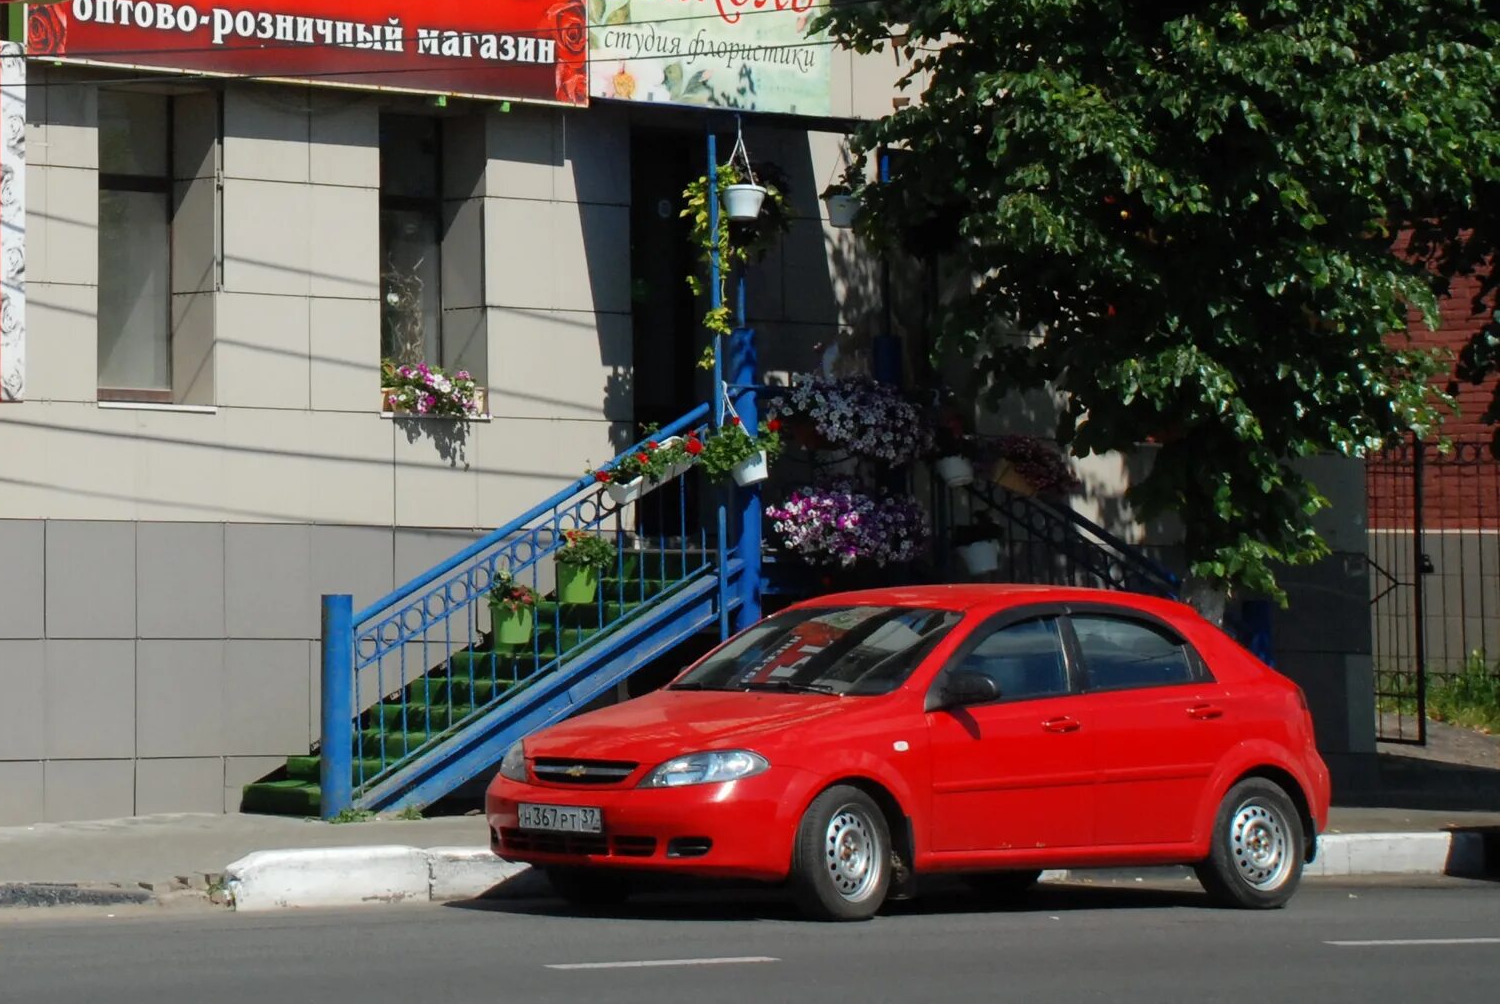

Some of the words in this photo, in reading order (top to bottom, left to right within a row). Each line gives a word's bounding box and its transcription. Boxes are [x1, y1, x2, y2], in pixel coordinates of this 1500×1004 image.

[417, 28, 556, 64] магазин
[604, 24, 681, 57] студия
[687, 28, 816, 73] флористики
